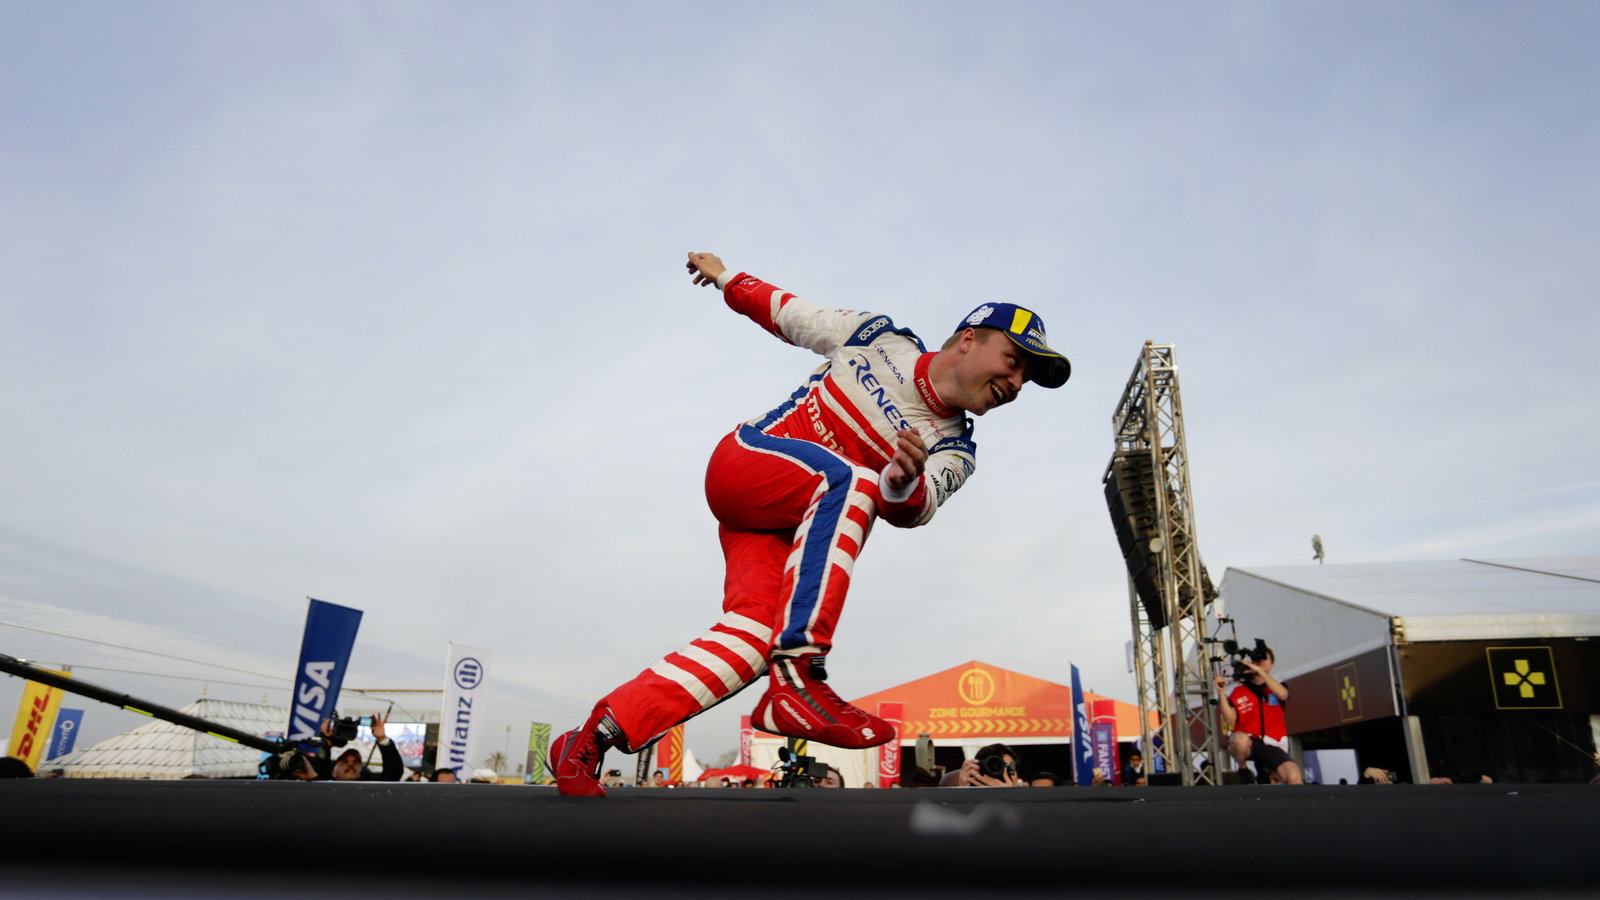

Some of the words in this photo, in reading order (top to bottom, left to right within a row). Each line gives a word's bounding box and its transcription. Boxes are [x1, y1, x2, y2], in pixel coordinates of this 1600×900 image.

[848, 353, 912, 431] RENES
[17, 693, 50, 758] DHL
[289, 661, 336, 741] VISA
[929, 707, 959, 718] ZONE
[960, 706, 1026, 718] GOURMANDE
[1077, 702, 1094, 763] VISA
[450, 696, 473, 782] Allianz
